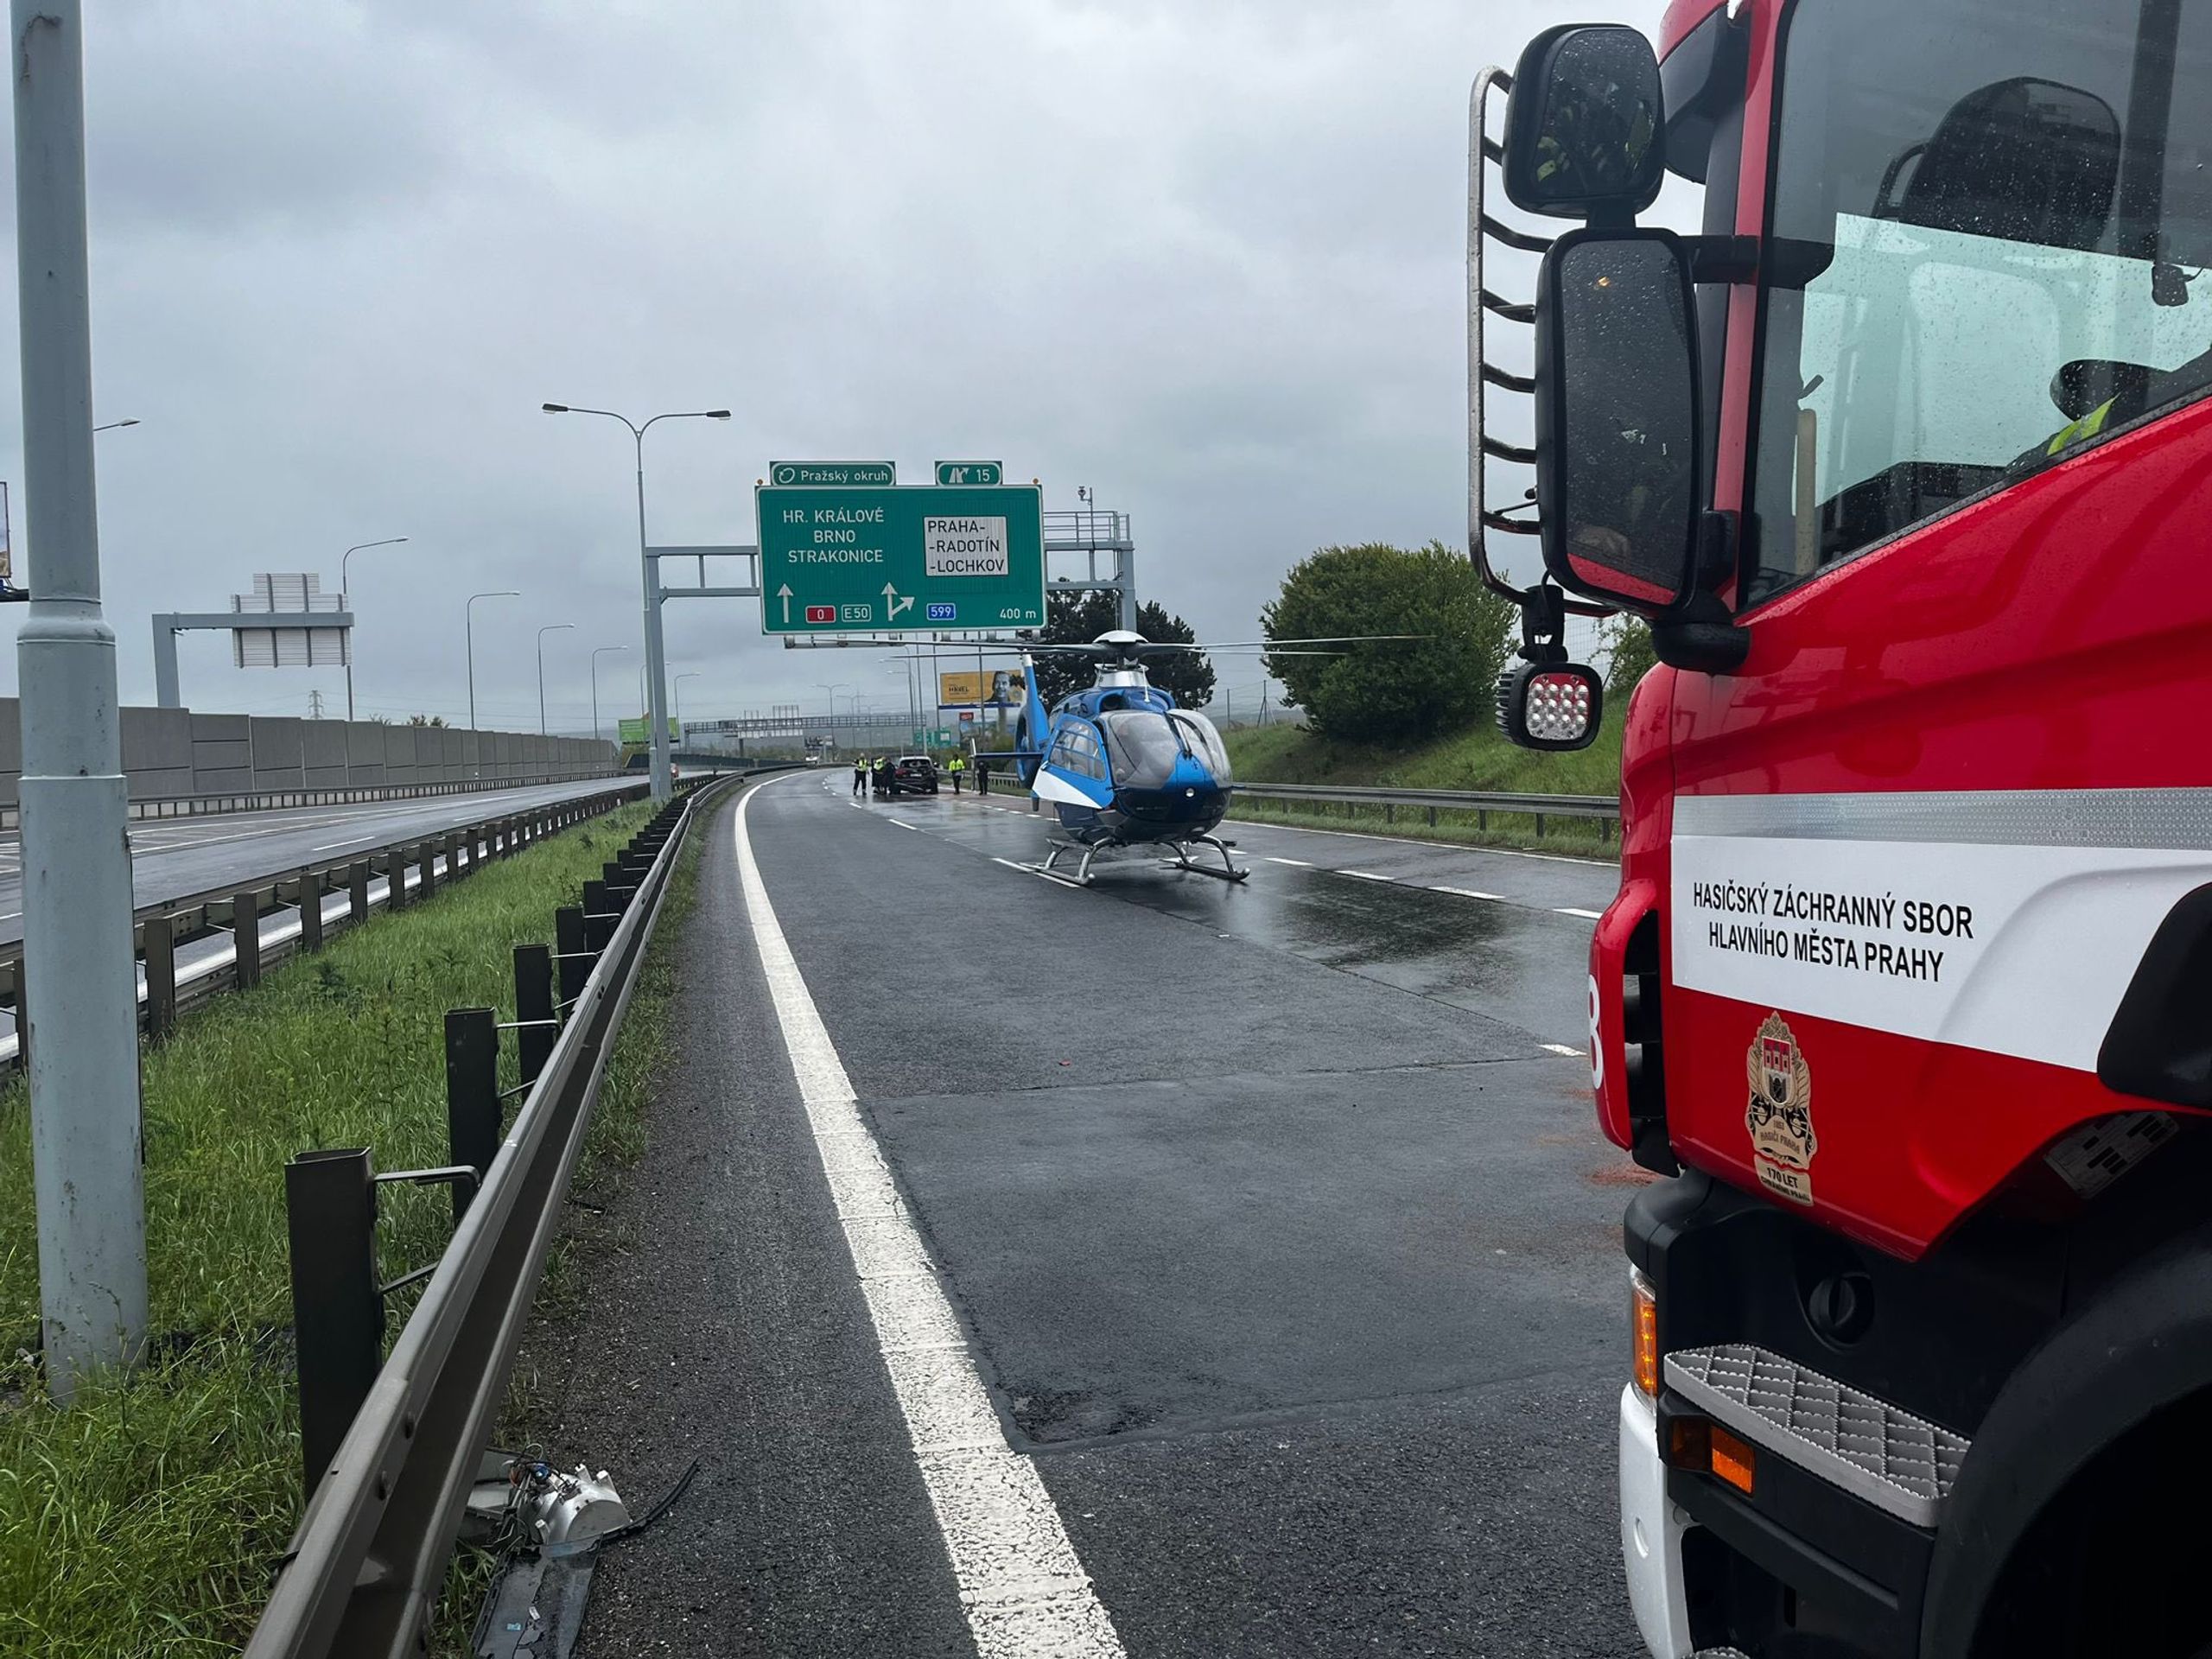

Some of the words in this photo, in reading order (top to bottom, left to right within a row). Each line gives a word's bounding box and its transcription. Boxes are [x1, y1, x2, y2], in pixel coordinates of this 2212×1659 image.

[800, 470, 849, 485] Pražský
[854, 470, 888, 481] okruh
[976, 469, 990, 482] 15
[783, 510, 809, 523] HR.
[815, 506, 885, 523] KRÁLOVÉ
[927, 520, 986, 534] PRAHA-
[814, 530, 855, 543] BRNO
[929, 539, 1000, 553] -RADOTÍN
[788, 550, 884, 563] STRAKONICE
[930, 559, 1005, 573] -LOCHKOV
[817, 608, 824, 620] 0
[931, 607, 951, 618] 599
[1000, 608, 1020, 620] 400
[1025, 611, 1036, 620] m
[1694, 879, 1769, 915] HASIČSKÝ
[1773, 883, 1896, 929] ZÁCHRANNÝ
[1904, 900, 1974, 939] SBOR
[1709, 921, 1788, 958] HLAVNÍHO
[1794, 928, 1859, 969] MĚSTA
[1865, 942, 1944, 982] PRAHY
[1767, 1167, 1782, 1182] 170
[1783, 1173, 1798, 1188] LET
